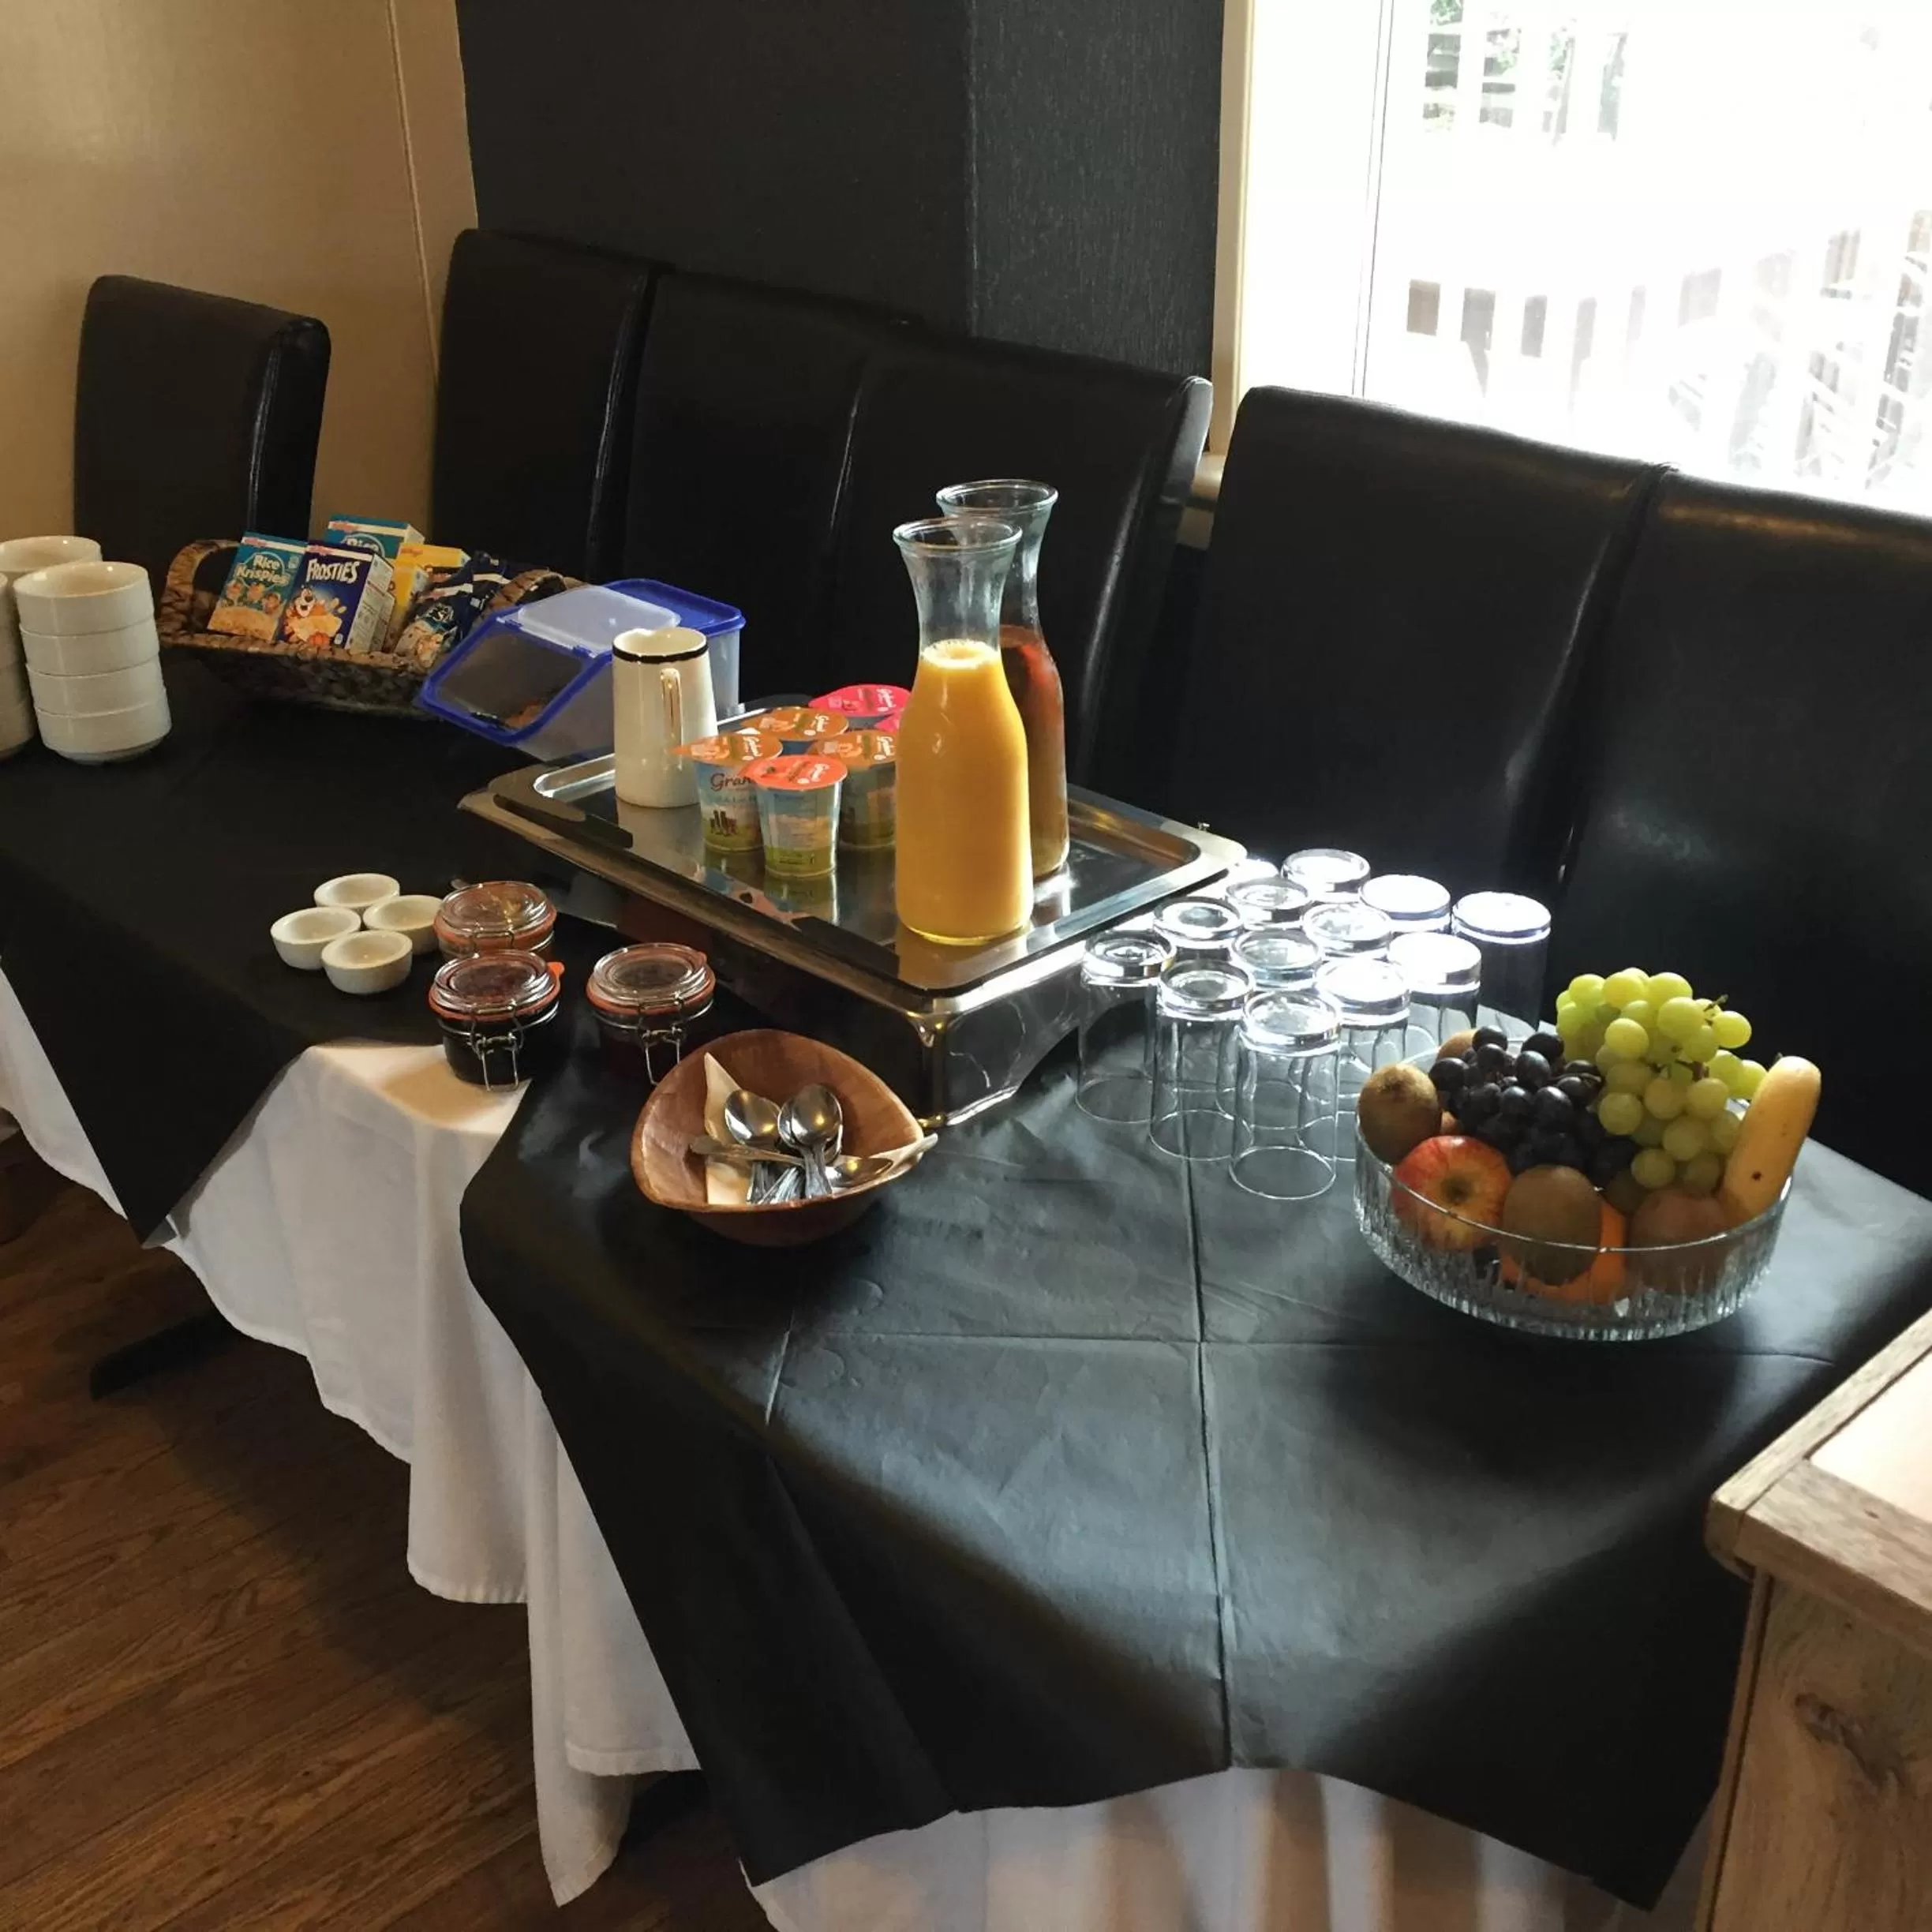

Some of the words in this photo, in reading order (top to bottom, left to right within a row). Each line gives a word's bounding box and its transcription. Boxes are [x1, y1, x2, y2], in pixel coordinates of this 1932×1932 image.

[253, 554, 280, 570] Rice
[305, 559, 360, 584] FROSTIES
[235, 564, 291, 585] Krispies
